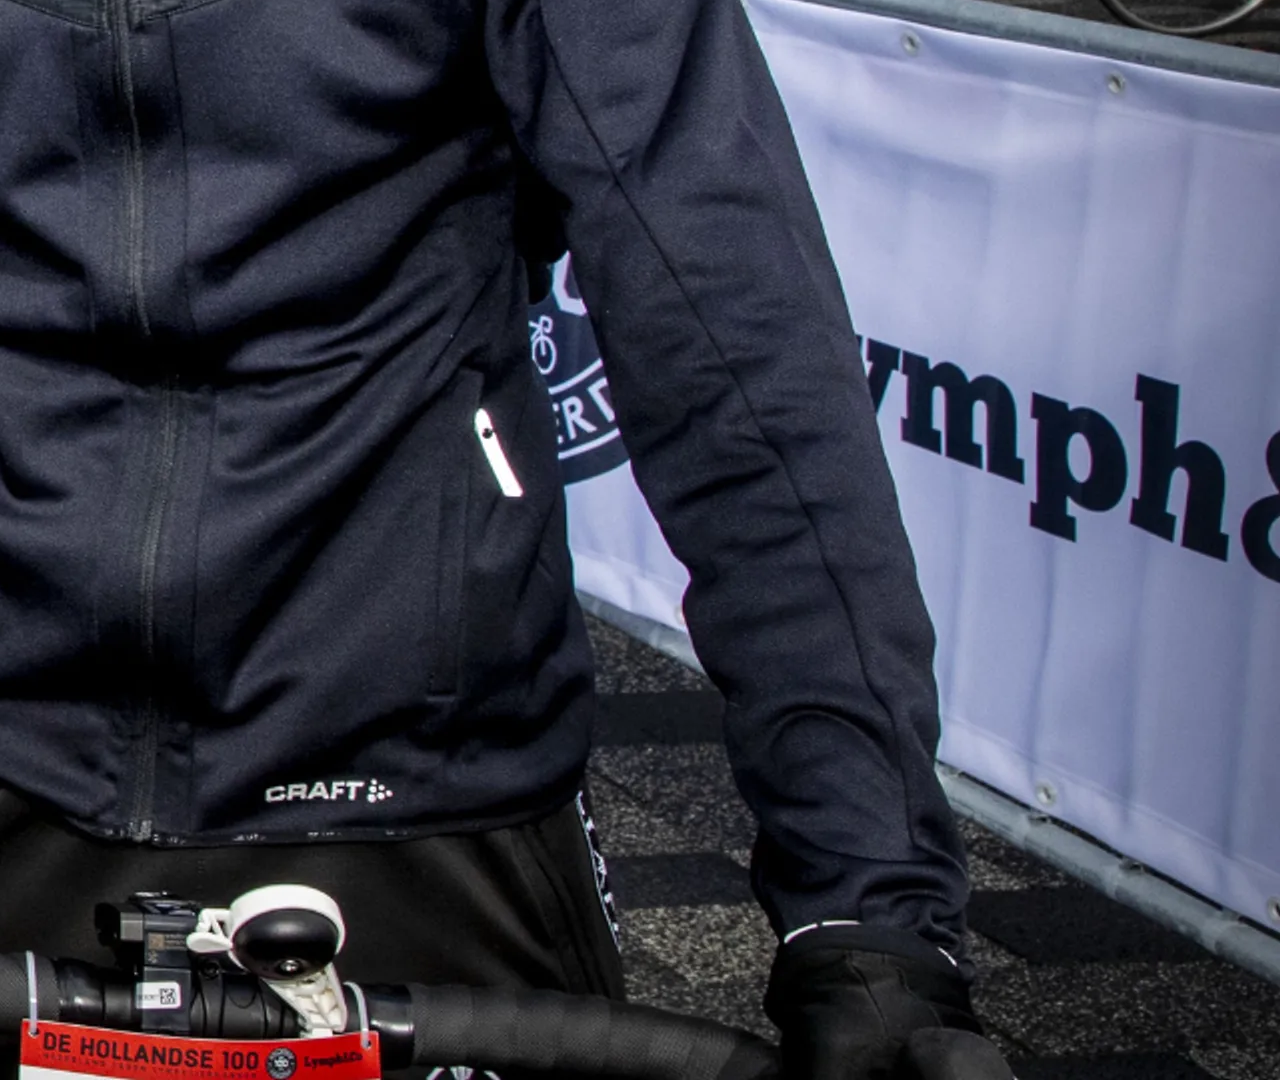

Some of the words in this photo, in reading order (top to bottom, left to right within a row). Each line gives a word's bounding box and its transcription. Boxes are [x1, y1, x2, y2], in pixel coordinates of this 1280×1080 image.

[265, 781, 365, 802] CRAFT
[43, 1032, 71, 1053] DE
[80, 1038, 213, 1069] HOLLANDSE
[222, 1051, 258, 1070] 100
